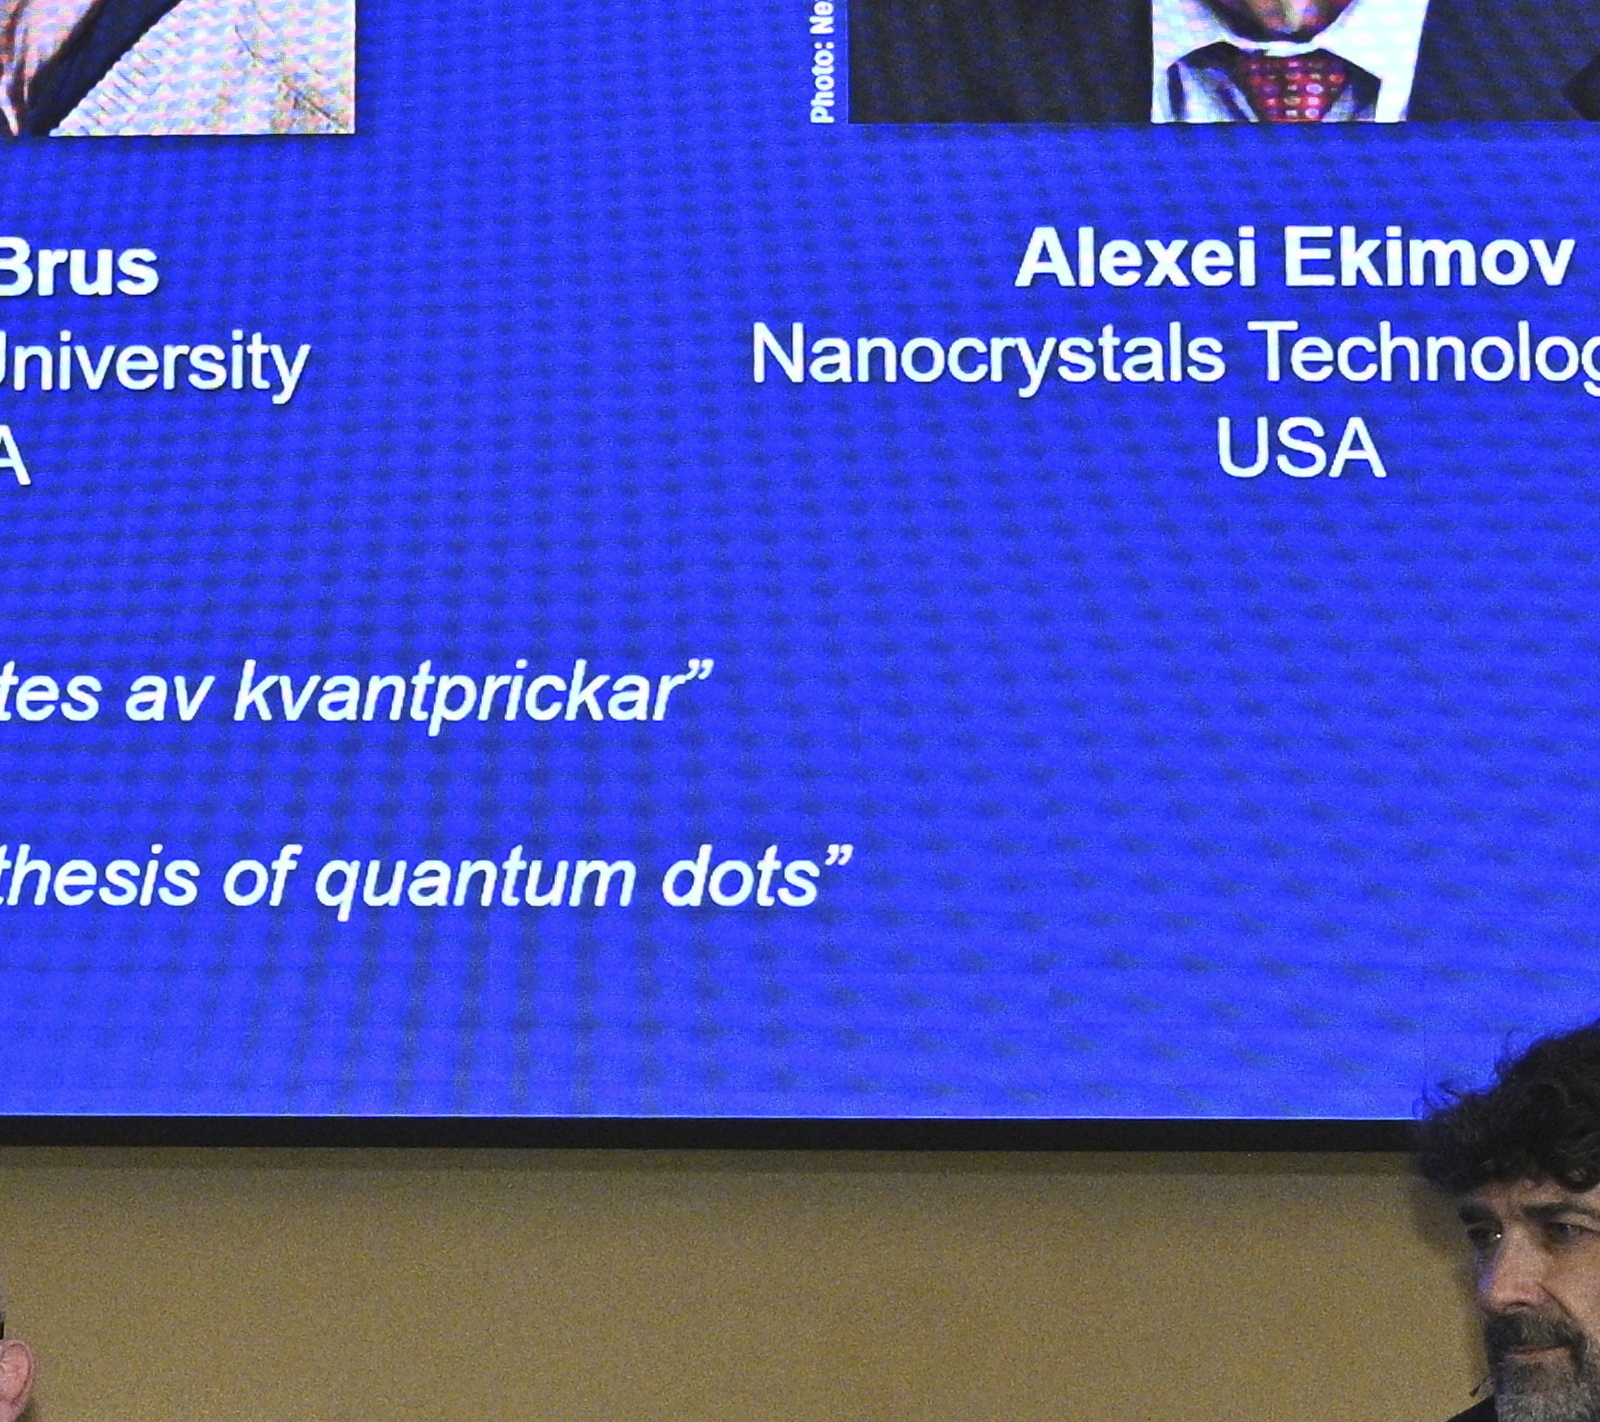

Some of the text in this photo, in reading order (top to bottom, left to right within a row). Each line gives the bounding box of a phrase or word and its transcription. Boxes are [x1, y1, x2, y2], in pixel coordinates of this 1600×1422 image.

[811, 42, 834, 123] Photo:
[1015, 226, 1575, 286] Alexei Ekimov
[754, 322, 1225, 397] Nanocrystals
[1218, 417, 1386, 477] USA
[126, 676, 215, 720] av
[224, 845, 302, 906] of
[316, 845, 636, 922] quantum
